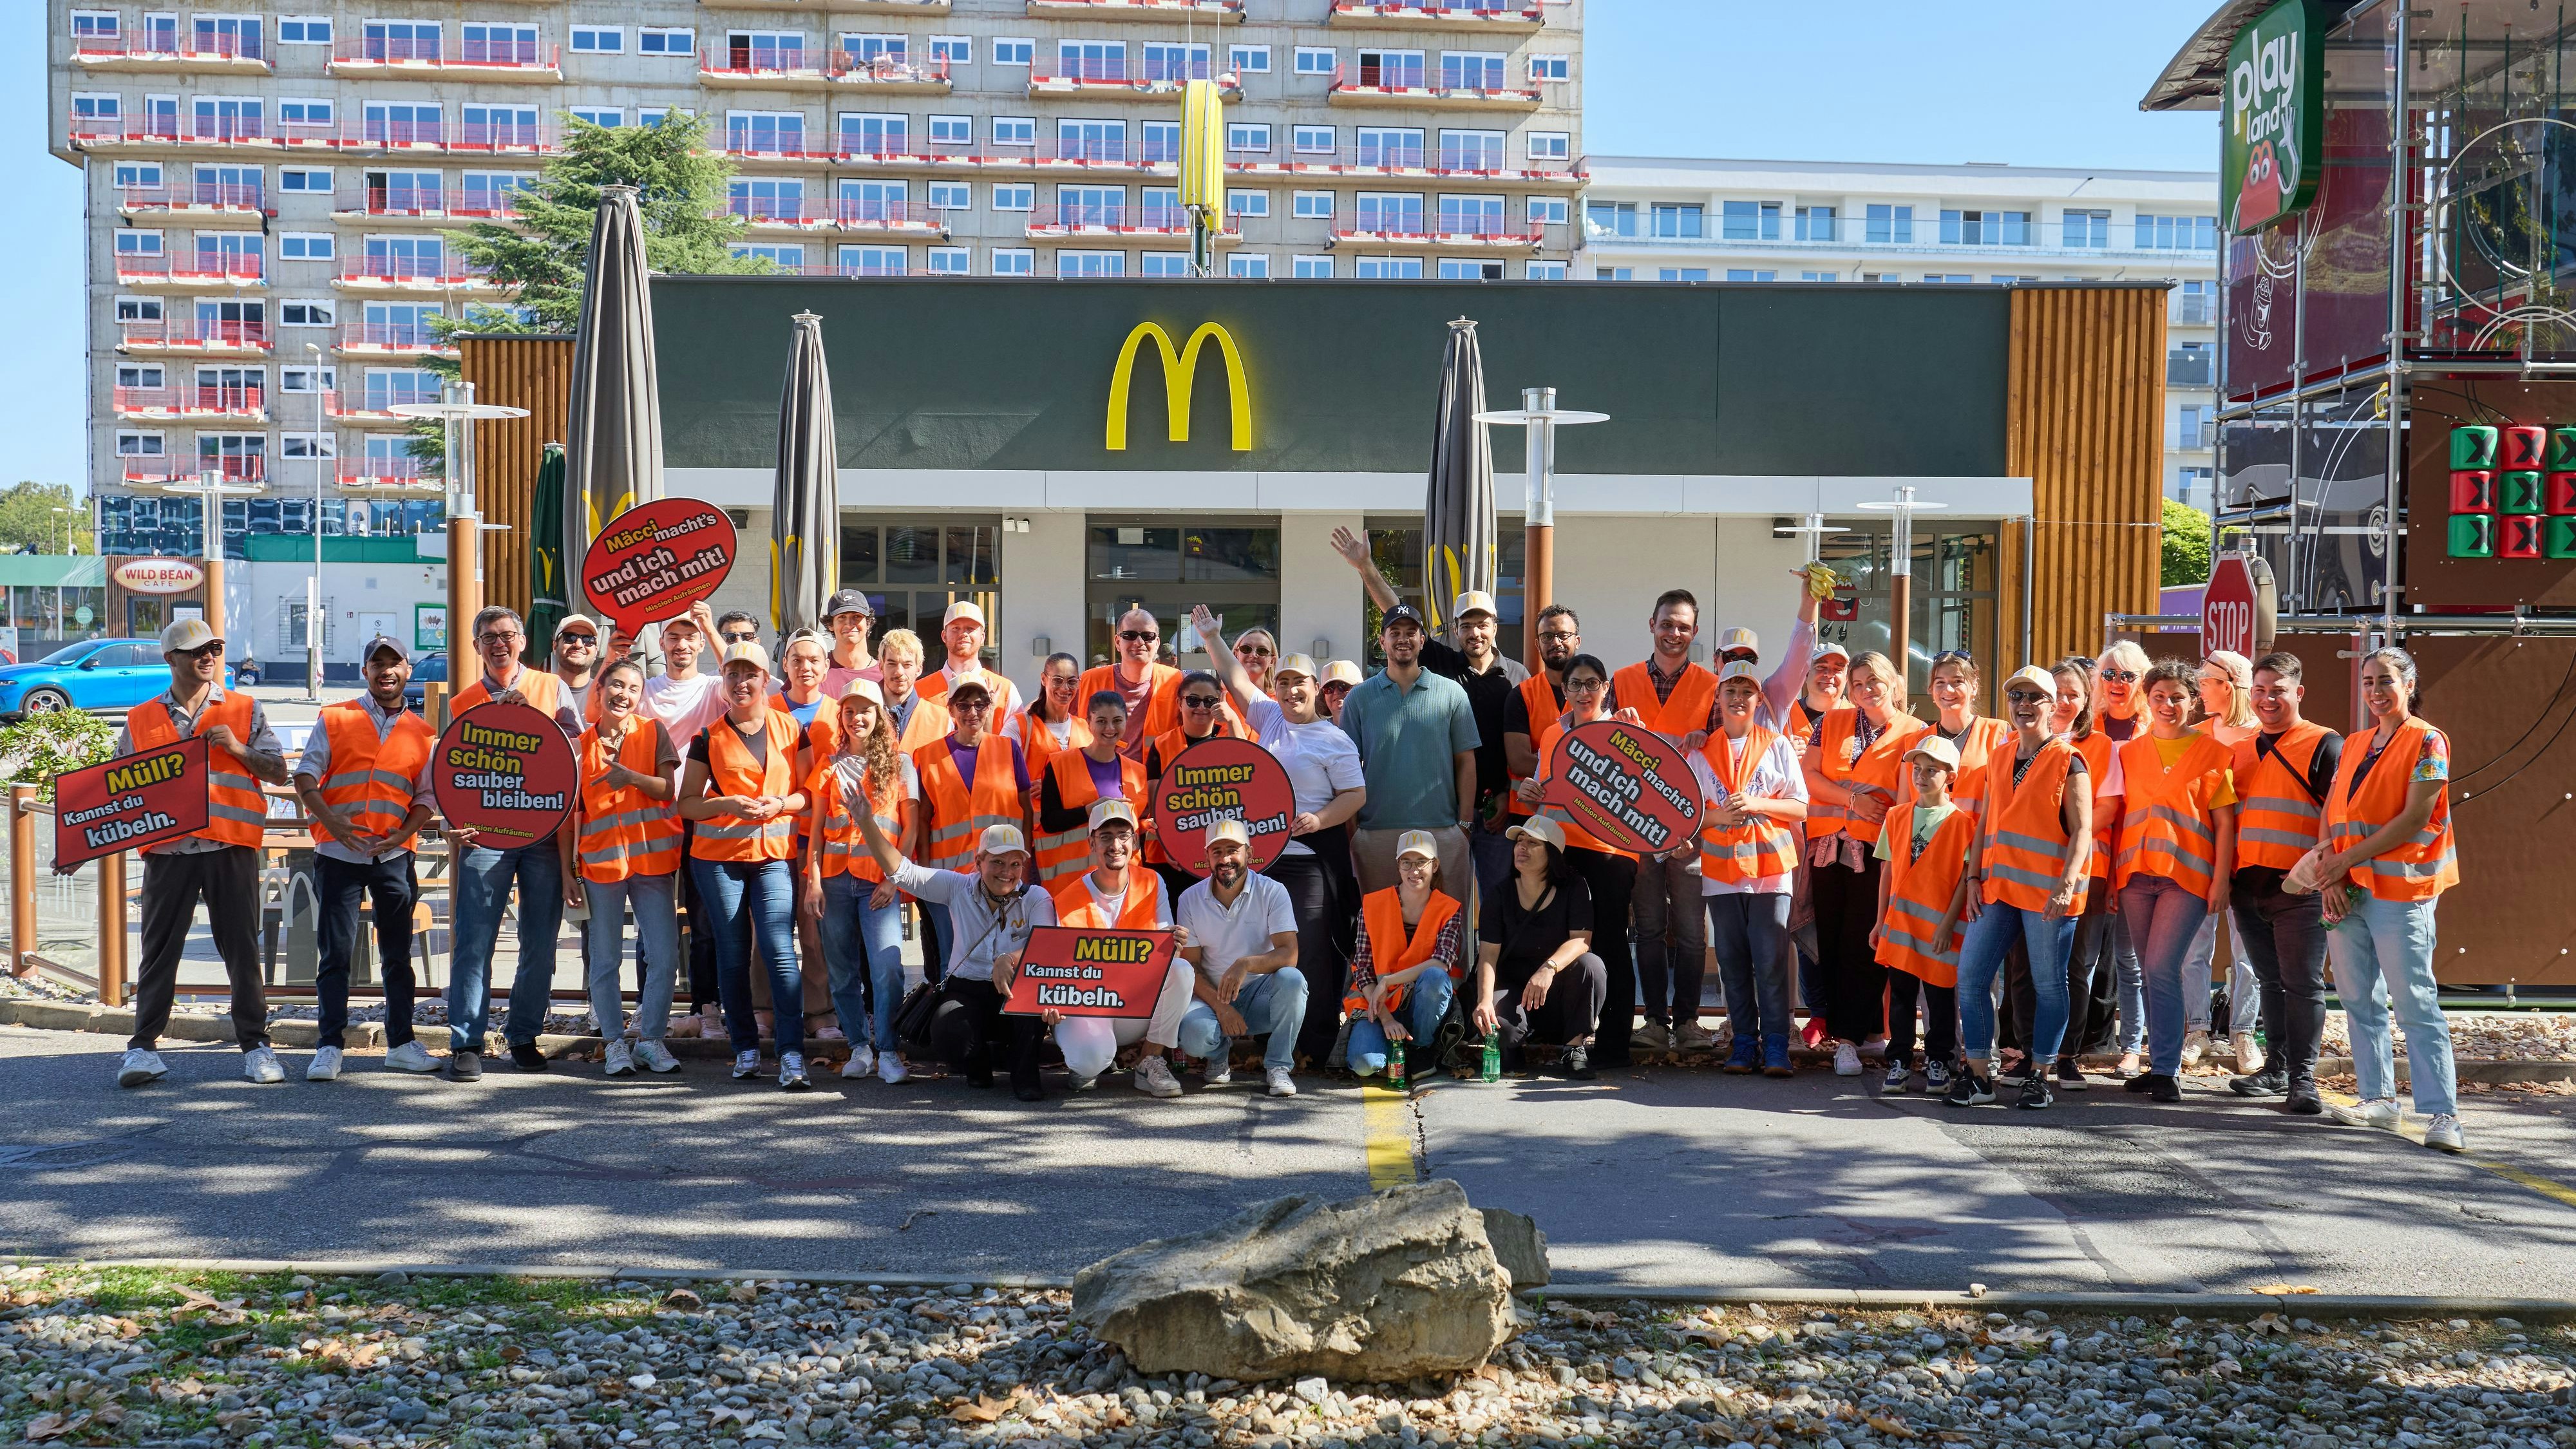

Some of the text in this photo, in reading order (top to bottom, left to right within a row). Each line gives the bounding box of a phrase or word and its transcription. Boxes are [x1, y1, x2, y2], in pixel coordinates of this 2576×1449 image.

[2233, 28, 2298, 136] play
[2246, 92, 2280, 145] land
[605, 520, 659, 553] Mäcci
[125, 569, 193, 580] WILD BEAN
[592, 549, 675, 592] und ich
[616, 547, 726, 605] mach mit!
[645, 582, 711, 613] Mission Aufräumen
[2207, 601, 2249, 652] STOP
[462, 722, 540, 752] Immer
[1610, 731, 1660, 771] Mäcci
[106, 753, 184, 794] Müll?
[449, 749, 521, 774] schön
[1177, 765, 1253, 786] Immer
[1569, 739, 1640, 801] und ich
[454, 771, 524, 789] sauber
[63, 795, 144, 826] Kannst du
[482, 790, 564, 810] bleiben!
[1168, 787, 1238, 810] schön
[1567, 766, 1668, 846] mach mit!
[85, 812, 176, 848] kübeln.
[463, 822, 534, 838] Mission Aufräumen
[1177, 805, 1245, 831] sauber
[1573, 797, 1632, 845] Mission Aufräumen
[1075, 938, 1153, 962] Müll?
[1025, 963, 1102, 979] Kannst du
[1039, 985, 1124, 1007] kübeln.
